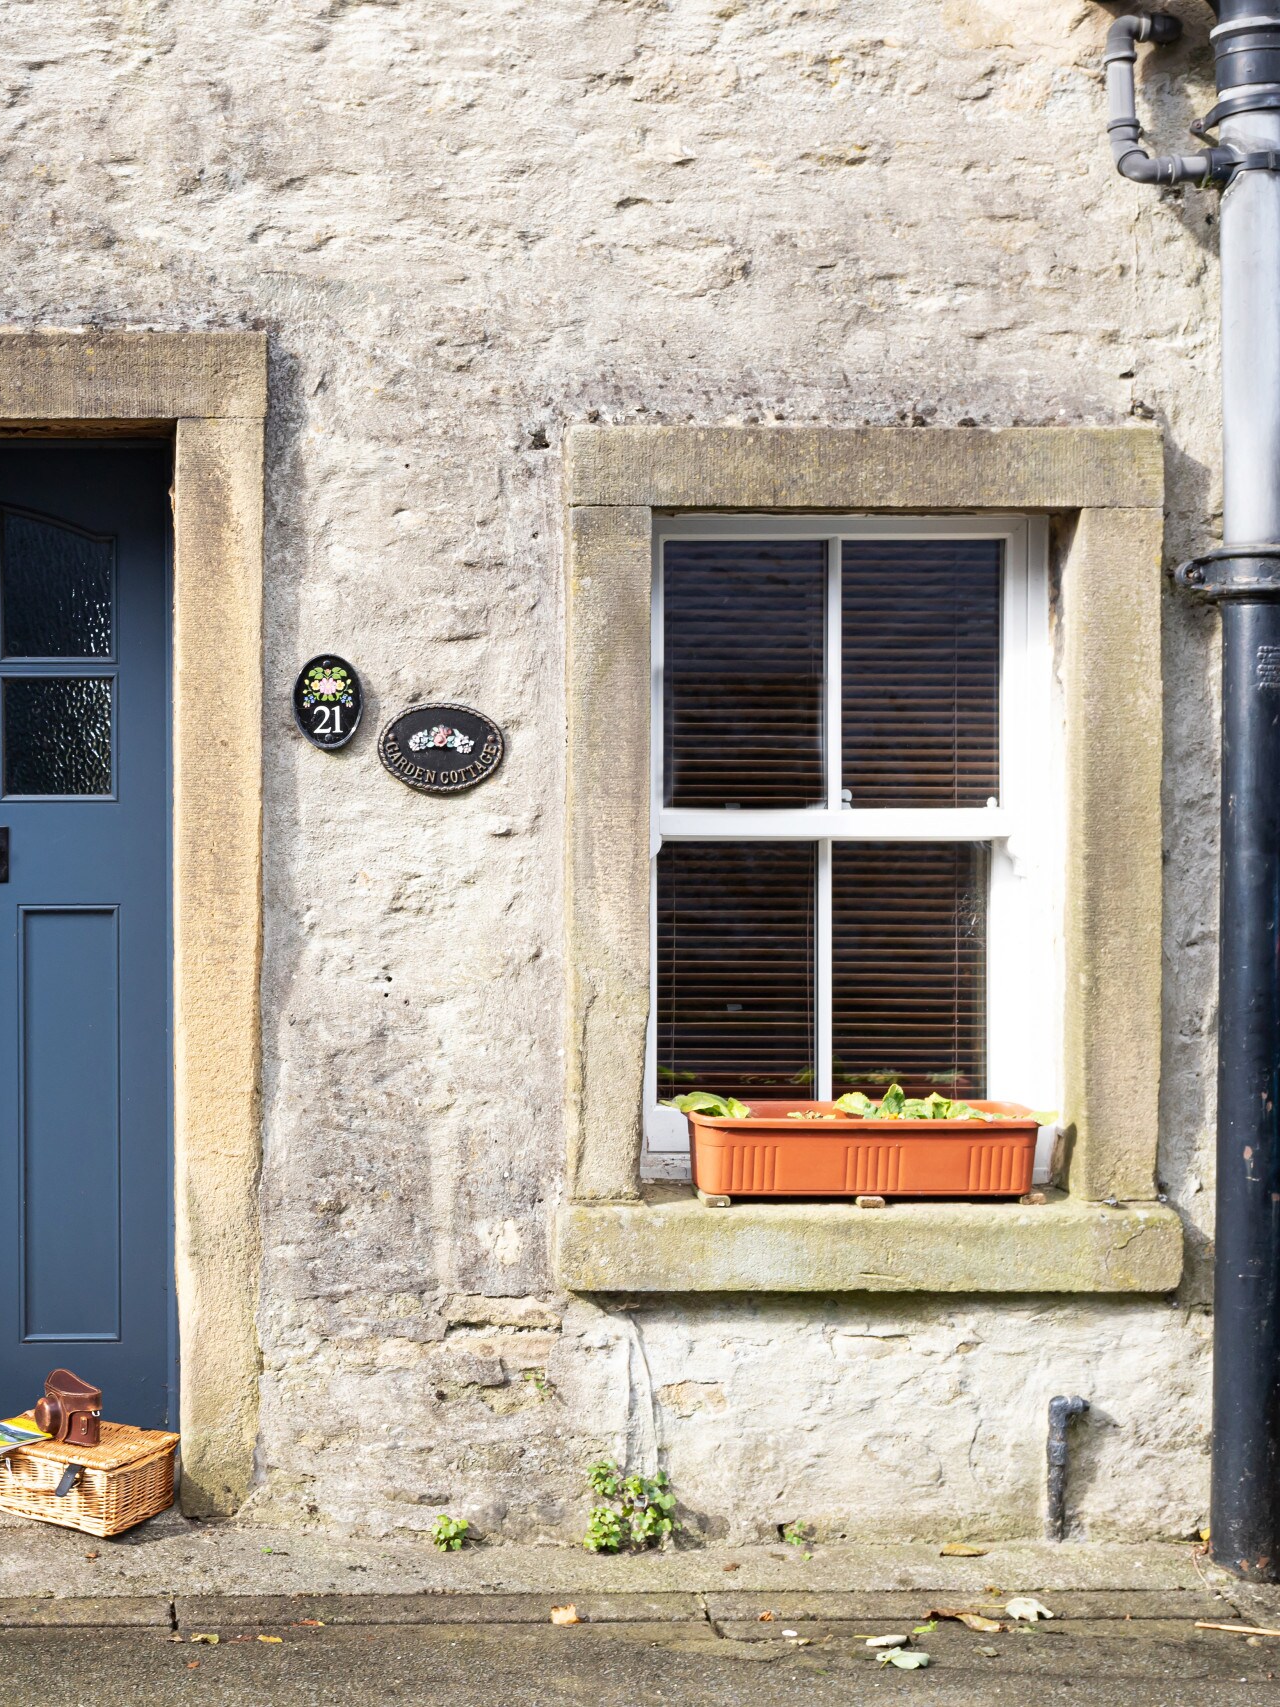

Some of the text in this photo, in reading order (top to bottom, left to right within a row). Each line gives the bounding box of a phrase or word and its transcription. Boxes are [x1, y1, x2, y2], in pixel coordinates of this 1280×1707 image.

[313, 705, 344, 734] 21
[385, 742, 498, 784] GARDEN COTTAGE
